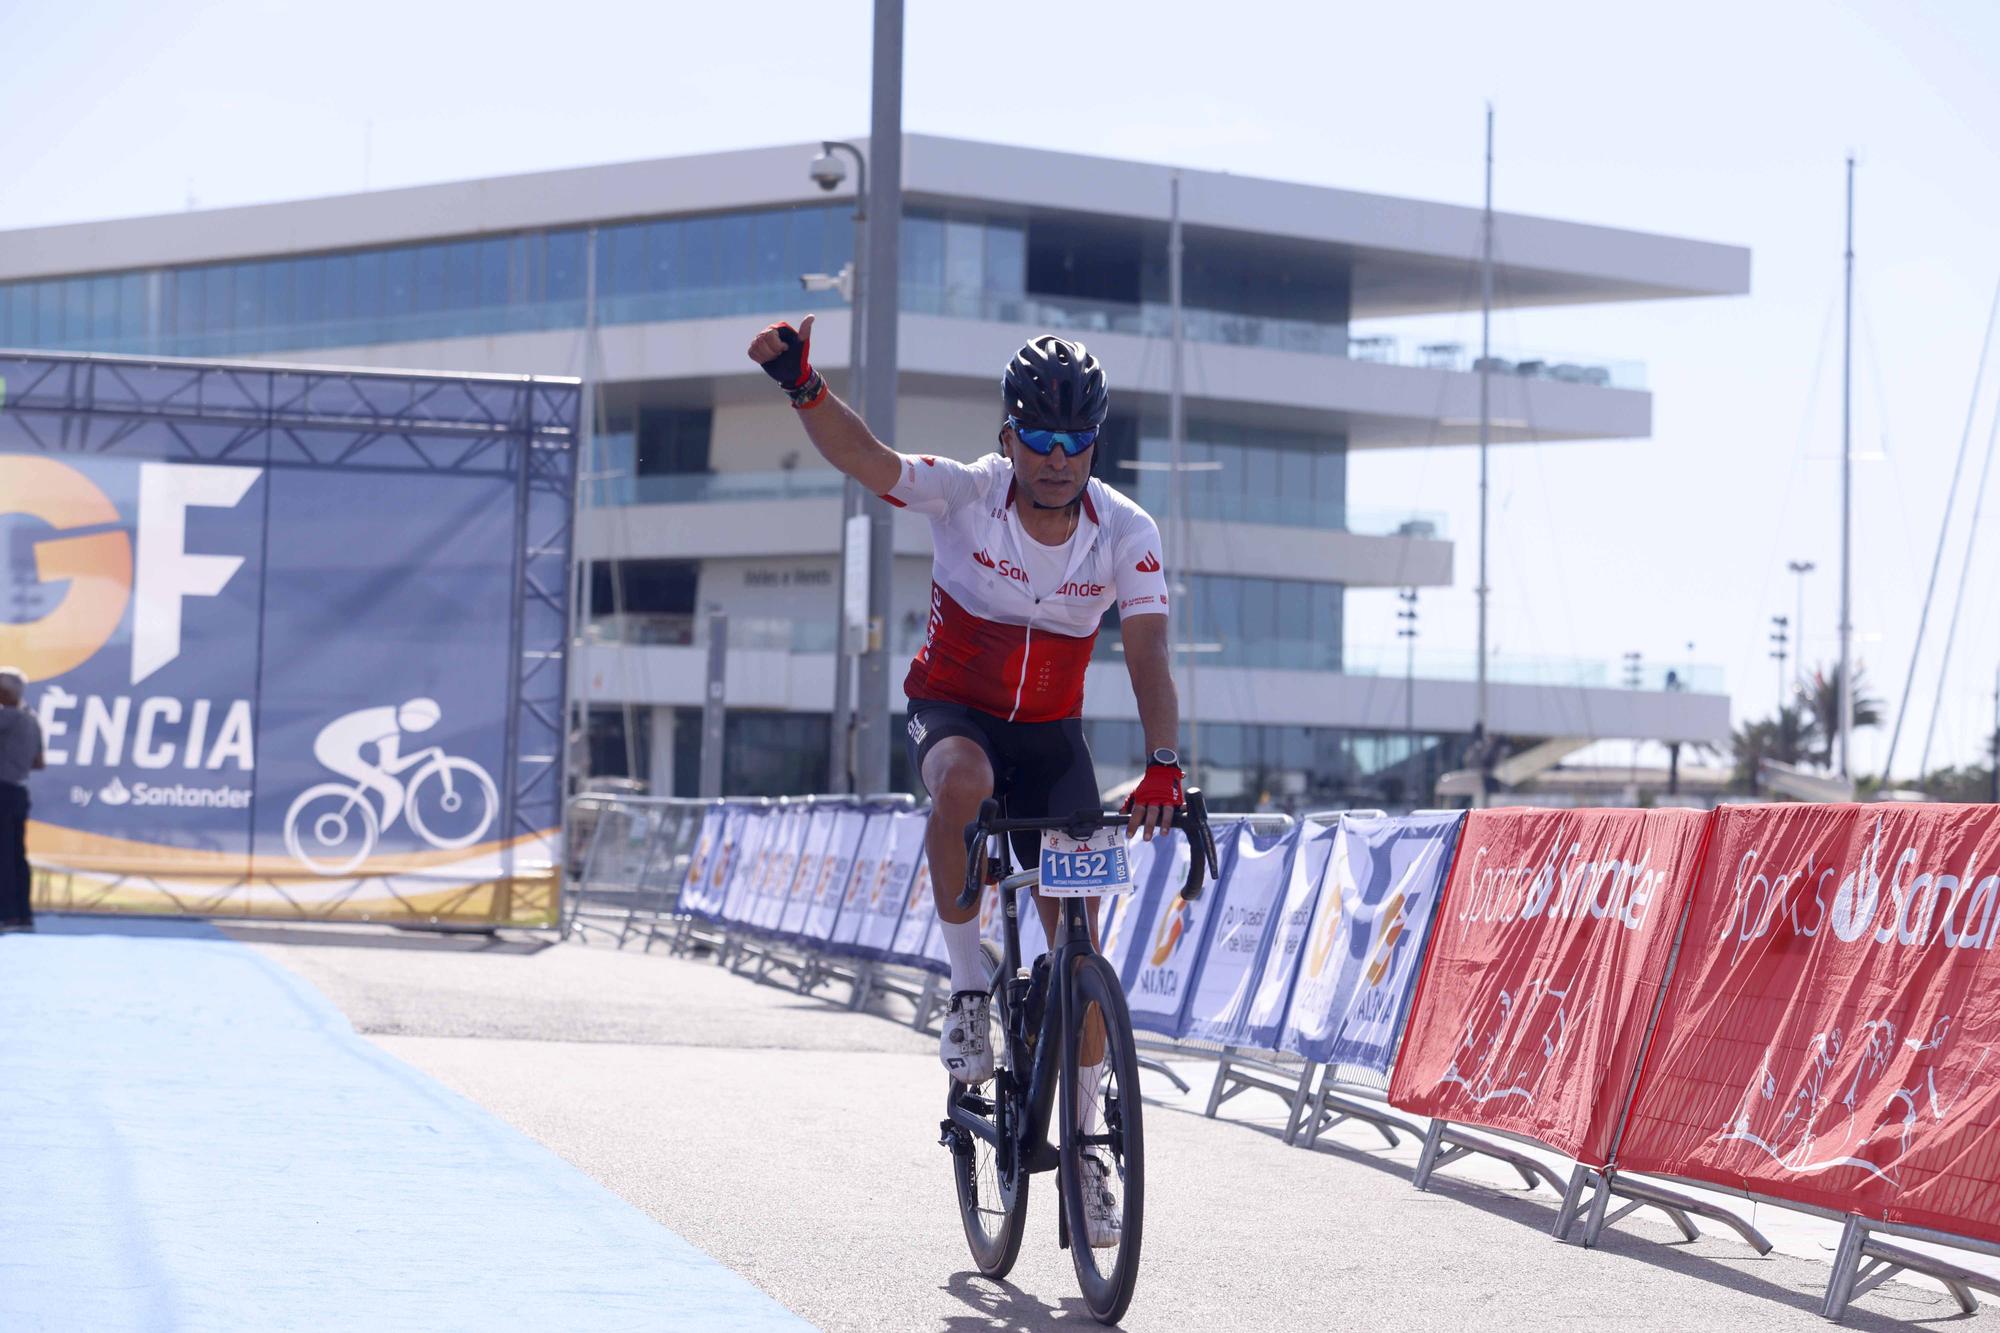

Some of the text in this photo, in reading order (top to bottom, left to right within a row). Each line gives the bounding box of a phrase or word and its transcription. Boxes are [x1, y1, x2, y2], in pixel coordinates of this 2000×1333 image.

[70, 782, 253, 808] By Santander
[1047, 853, 1108, 878] 1152
[1116, 849, 1126, 881] 105 km
